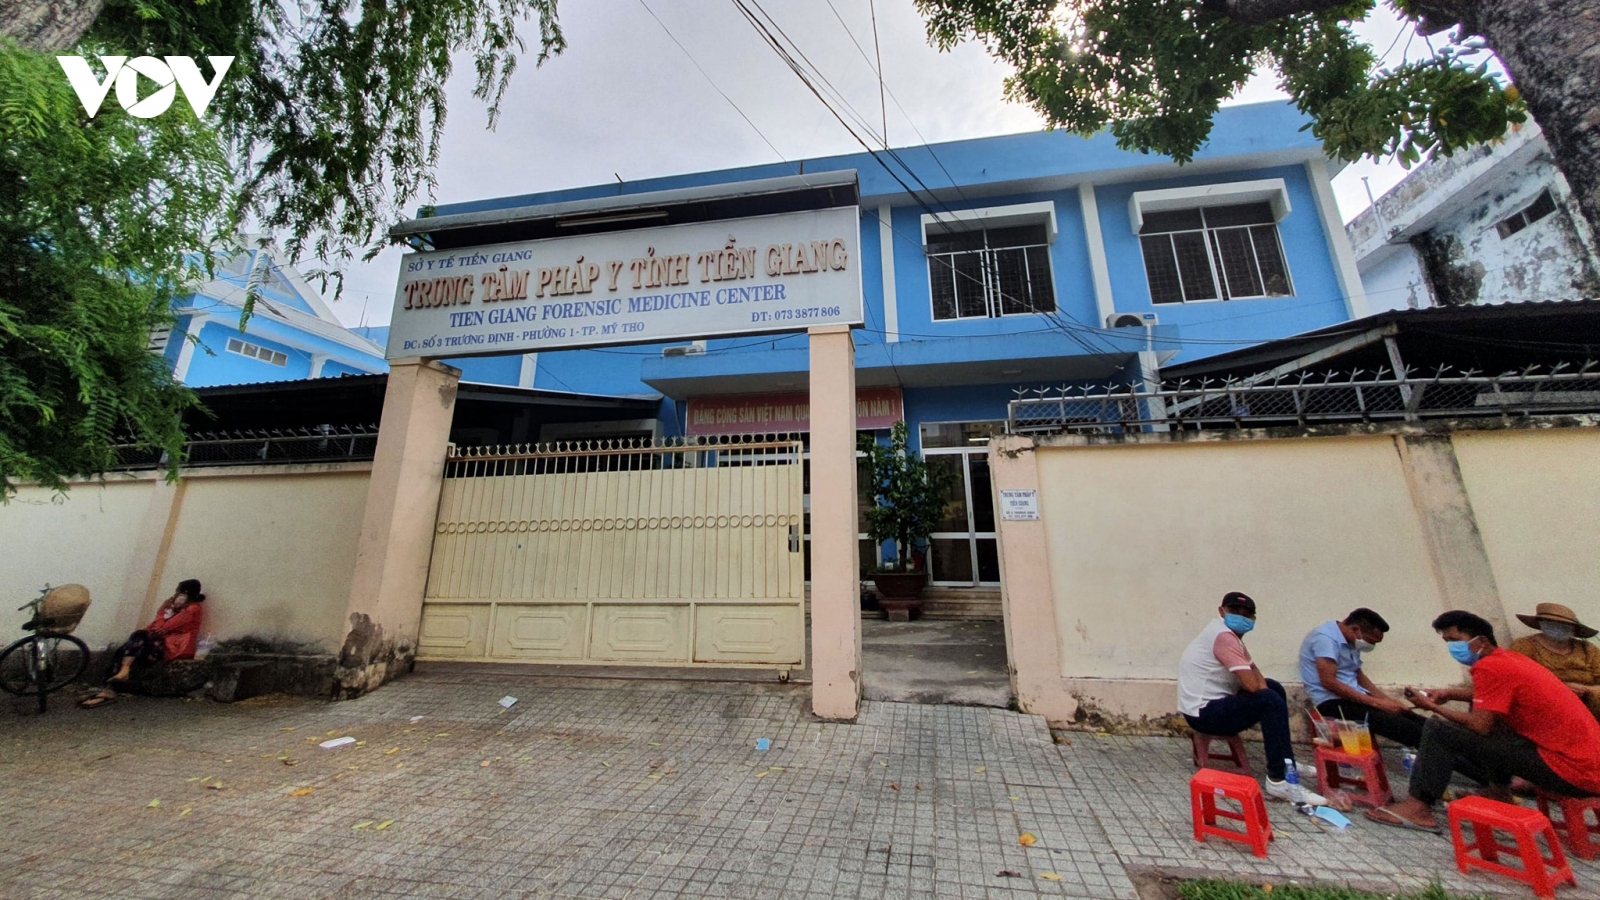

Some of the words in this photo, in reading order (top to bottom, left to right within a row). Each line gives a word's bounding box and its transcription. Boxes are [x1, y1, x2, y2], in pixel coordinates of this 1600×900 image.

[404, 274, 474, 309] TRUNG
[481, 264, 530, 302] TÂM
[536, 256, 600, 297] PHÁP
[606, 260, 623, 291] Y
[630, 247, 690, 289] TỈNH
[698, 233, 756, 283] TIỀN
[764, 237, 847, 277] GIANG
[408, 258, 424, 272] SỞ
[427, 261, 436, 270] Y
[438, 254, 455, 269] TẾ
[458, 251, 488, 266] TIỀN
[492, 250, 533, 263] GIANG
[450, 310, 485, 328] TIEN
[488, 306, 537, 324] GIANG
[542, 298, 622, 320] FORENSIC
[627, 290, 711, 313] MEDICINE
[716, 284, 787, 304] CENTER
[751, 311, 771, 322] ĐT:
[422, 334, 437, 348] SỐ
[445, 334, 484, 347] TRƯƠNG
[488, 332, 514, 345] ĐỊNH
[522, 325, 566, 340] PHƯỜNG
[601, 322, 618, 334] MỸ
[622, 321, 645, 333] THO
[716, 405, 737, 427] CỘNG
[739, 402, 755, 423] SẢN
[757, 403, 773, 426] VIỆT
[775, 405, 793, 421] NAM
[795, 404, 810, 422] QUA
[870, 397, 890, 417] NĂM
